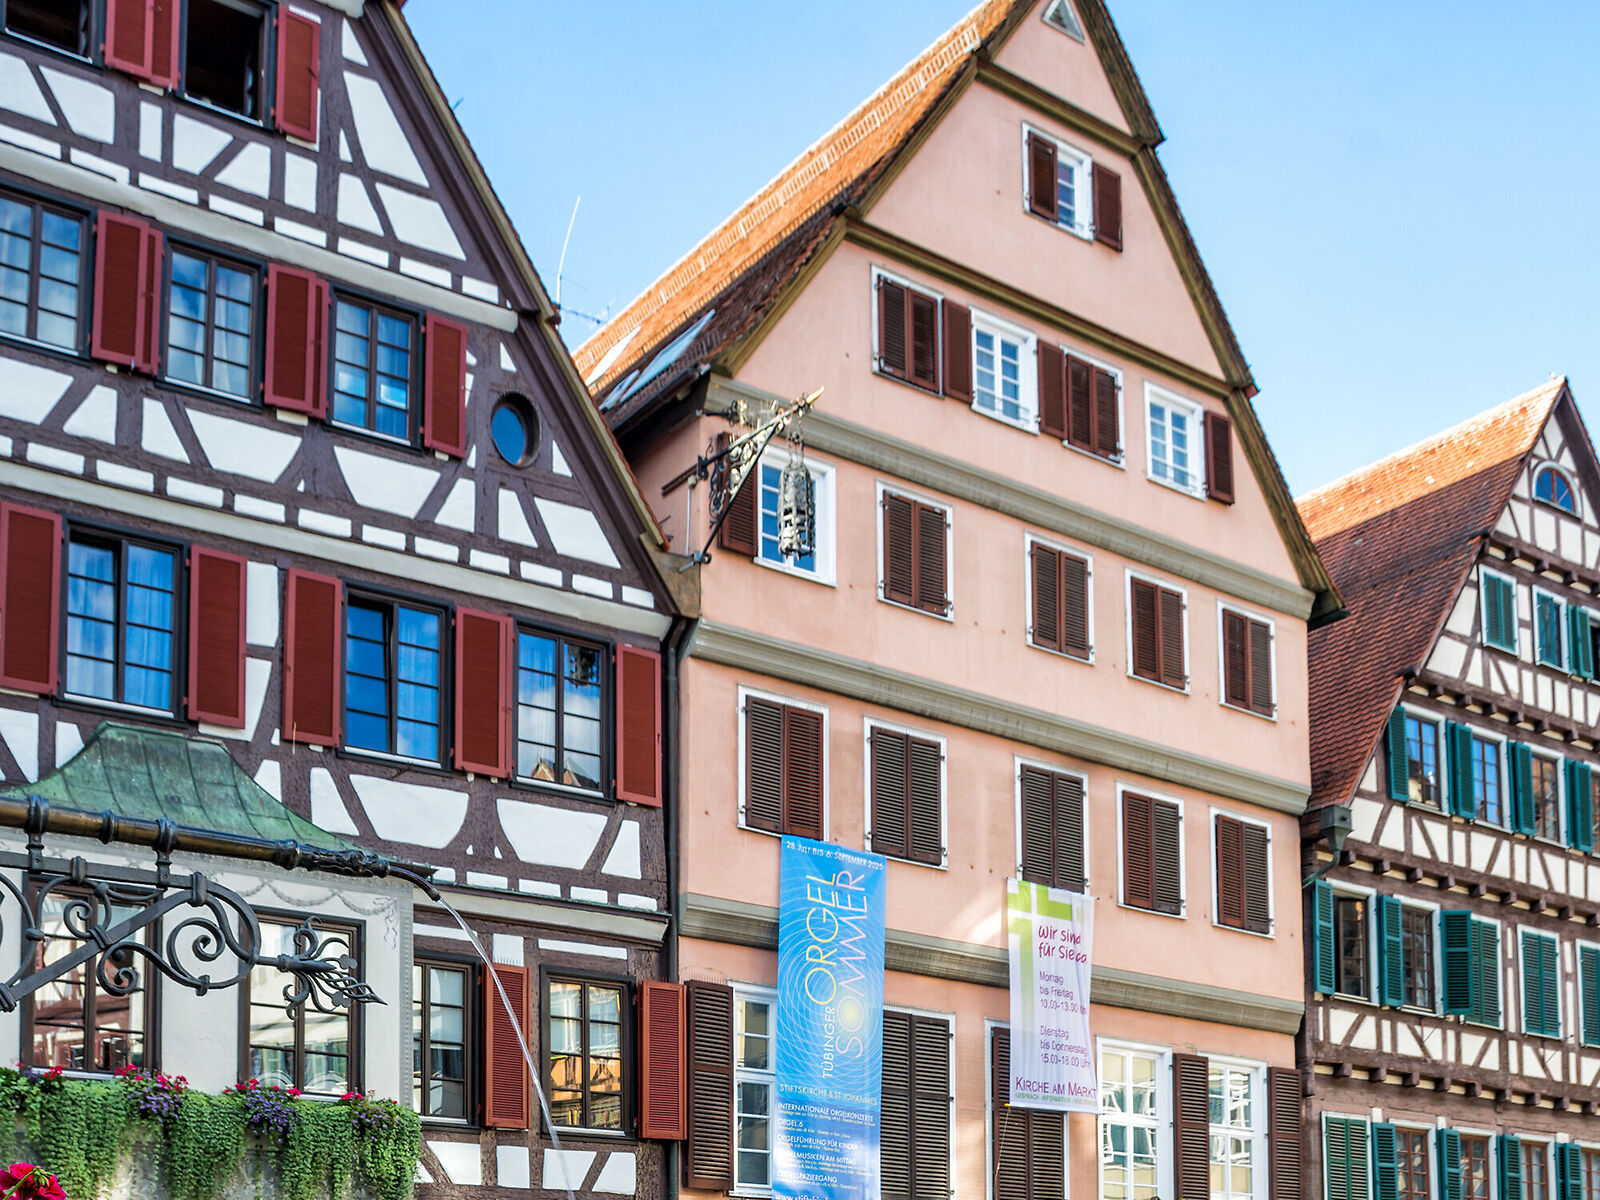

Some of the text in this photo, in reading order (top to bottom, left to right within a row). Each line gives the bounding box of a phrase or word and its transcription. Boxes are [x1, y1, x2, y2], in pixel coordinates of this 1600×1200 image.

[812, 848, 824, 857] BIS
[834, 851, 867, 867] SEPTEMBER
[804, 872, 839, 1006] ORGEL
[1037, 925, 1058, 940] Wir
[1038, 941, 1056, 958] für
[1058, 945, 1075, 960] Sie
[835, 870, 868, 1059] SOMMER
[1039, 970, 1064, 986] Montag
[1051, 986, 1074, 1001] Freitag
[1040, 1025, 1069, 1041] Dienstag
[820, 1006, 836, 1079] TÜBINGER
[1051, 1040, 1088, 1058] Donnerstag
[779, 1083, 828, 1097] STIFTSKIRCHE
[1015, 1076, 1097, 1100] KIRCHE AM MARKT
[777, 1102, 829, 1115] INTERNATIONALE
[830, 1108, 874, 1122] ORGELKONZERTE
[776, 1117, 799, 1127] ORGEL
[776, 1133, 827, 1147] ORGELFÜHRUNG
[827, 1139, 838, 1148] FÜR
